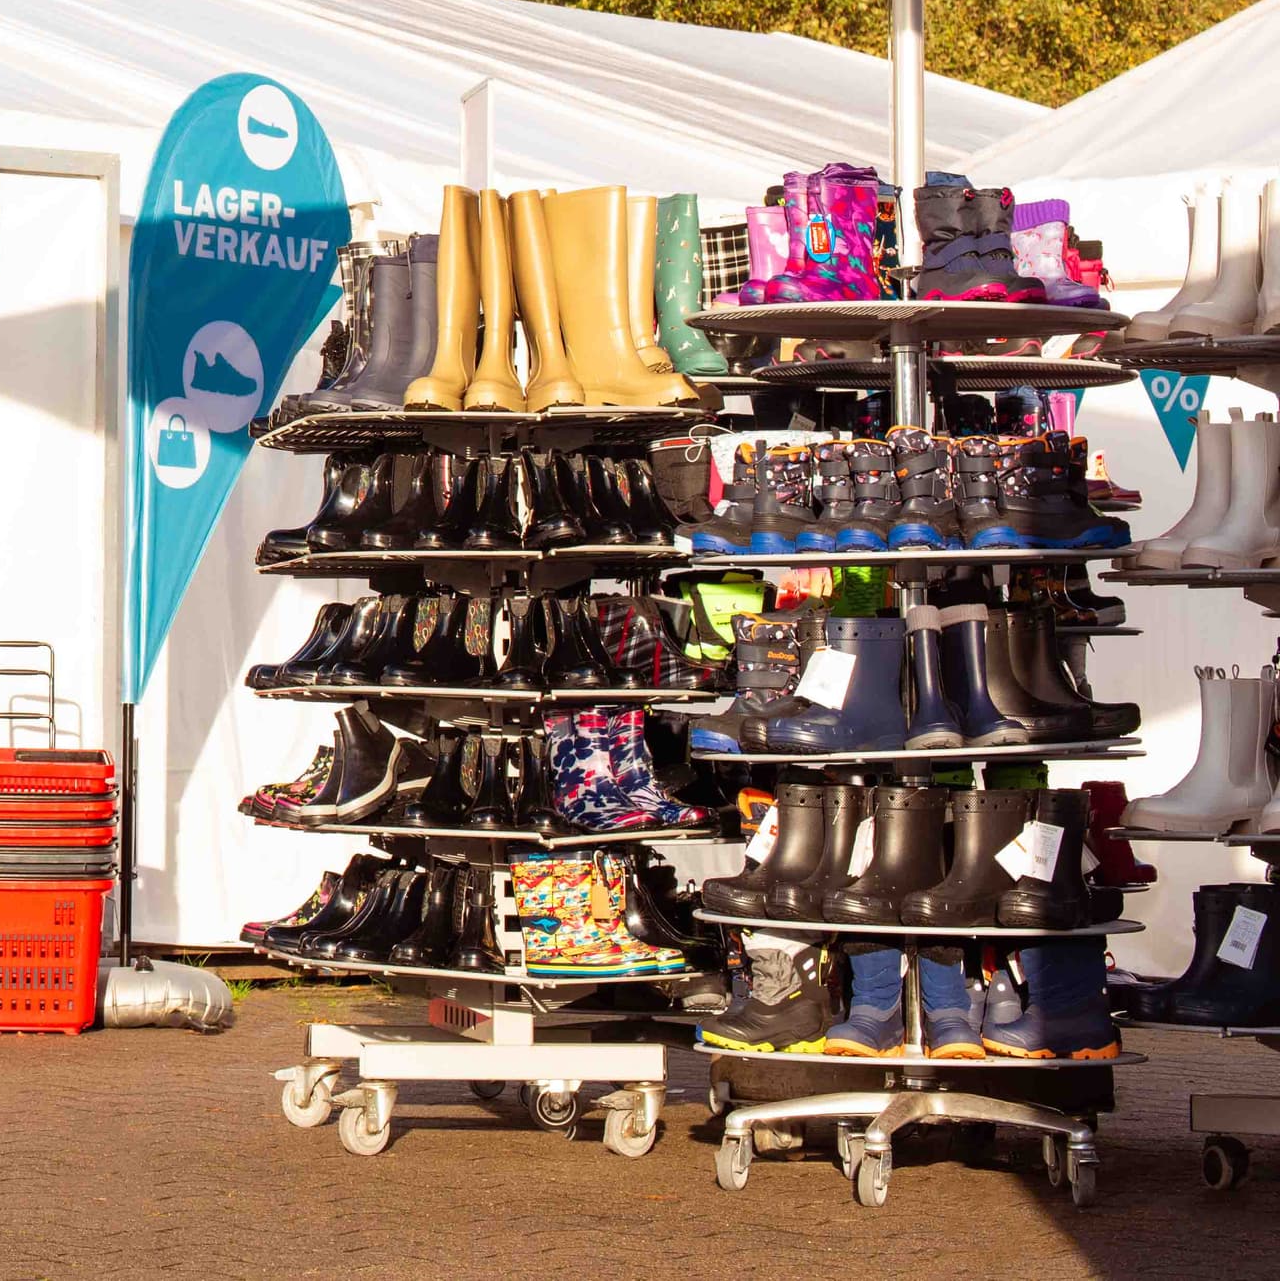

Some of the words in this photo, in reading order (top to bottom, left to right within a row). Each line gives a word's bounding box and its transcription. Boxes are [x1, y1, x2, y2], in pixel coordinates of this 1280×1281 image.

[174, 180, 296, 228] LAGER-
[175, 221, 329, 273] VERKAUF
[1151, 375, 1200, 413] %
